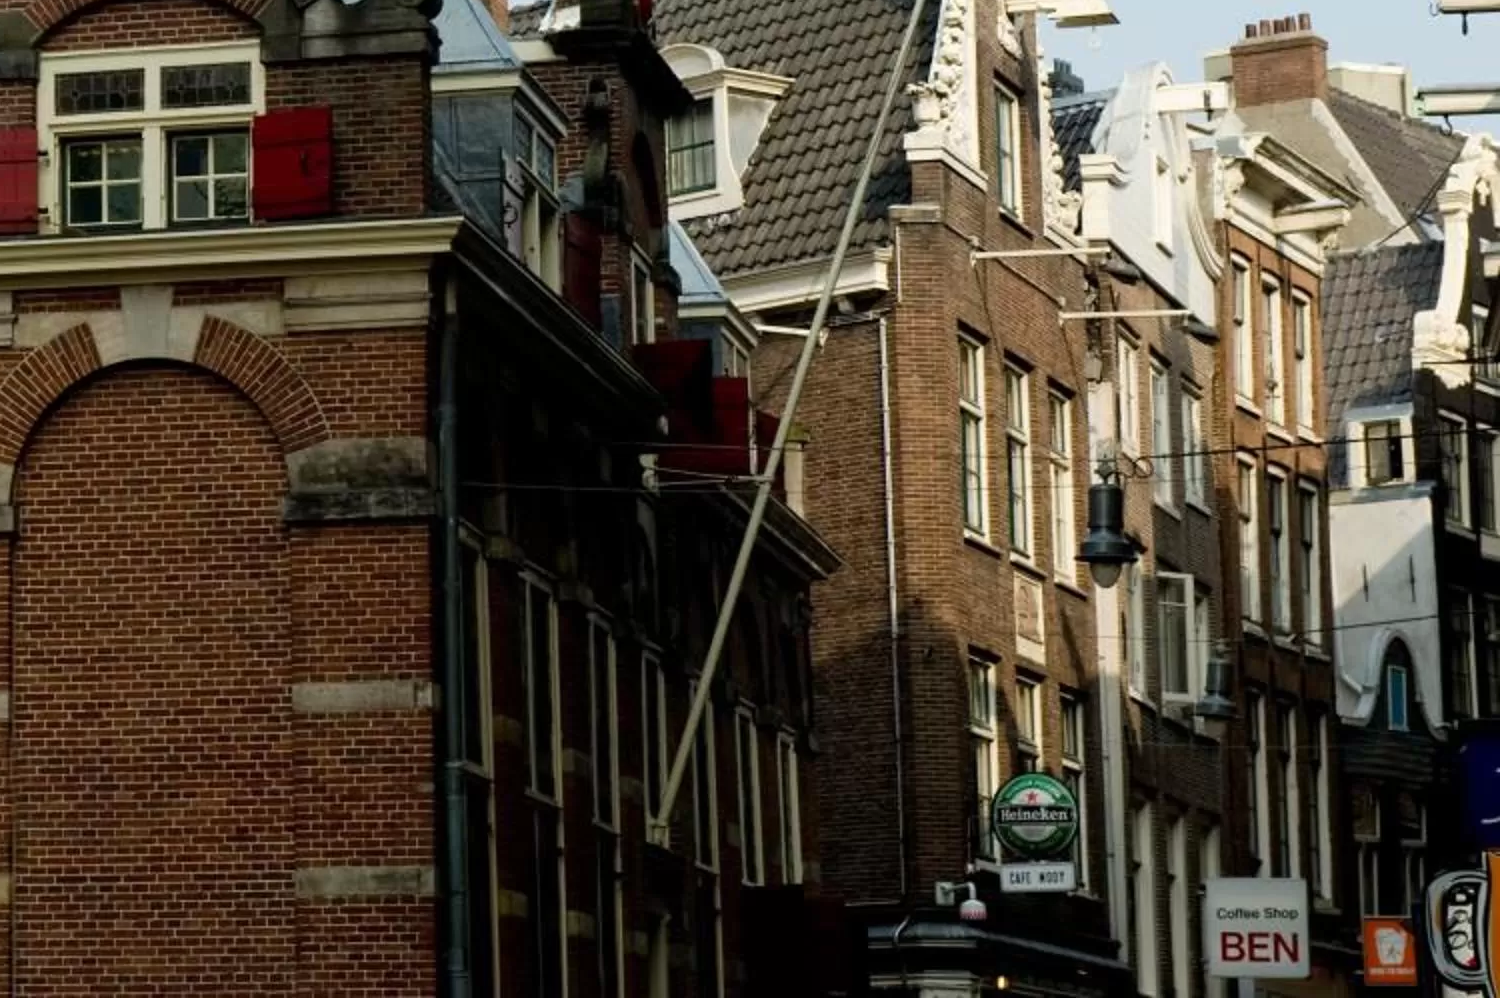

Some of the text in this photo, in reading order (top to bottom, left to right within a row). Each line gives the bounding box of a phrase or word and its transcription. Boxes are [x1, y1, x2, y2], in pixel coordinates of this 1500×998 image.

[1001, 807, 1068, 822] Heineken
[1217, 907, 1299, 920] Coffee Shop
[1220, 931, 1299, 963] BEN
